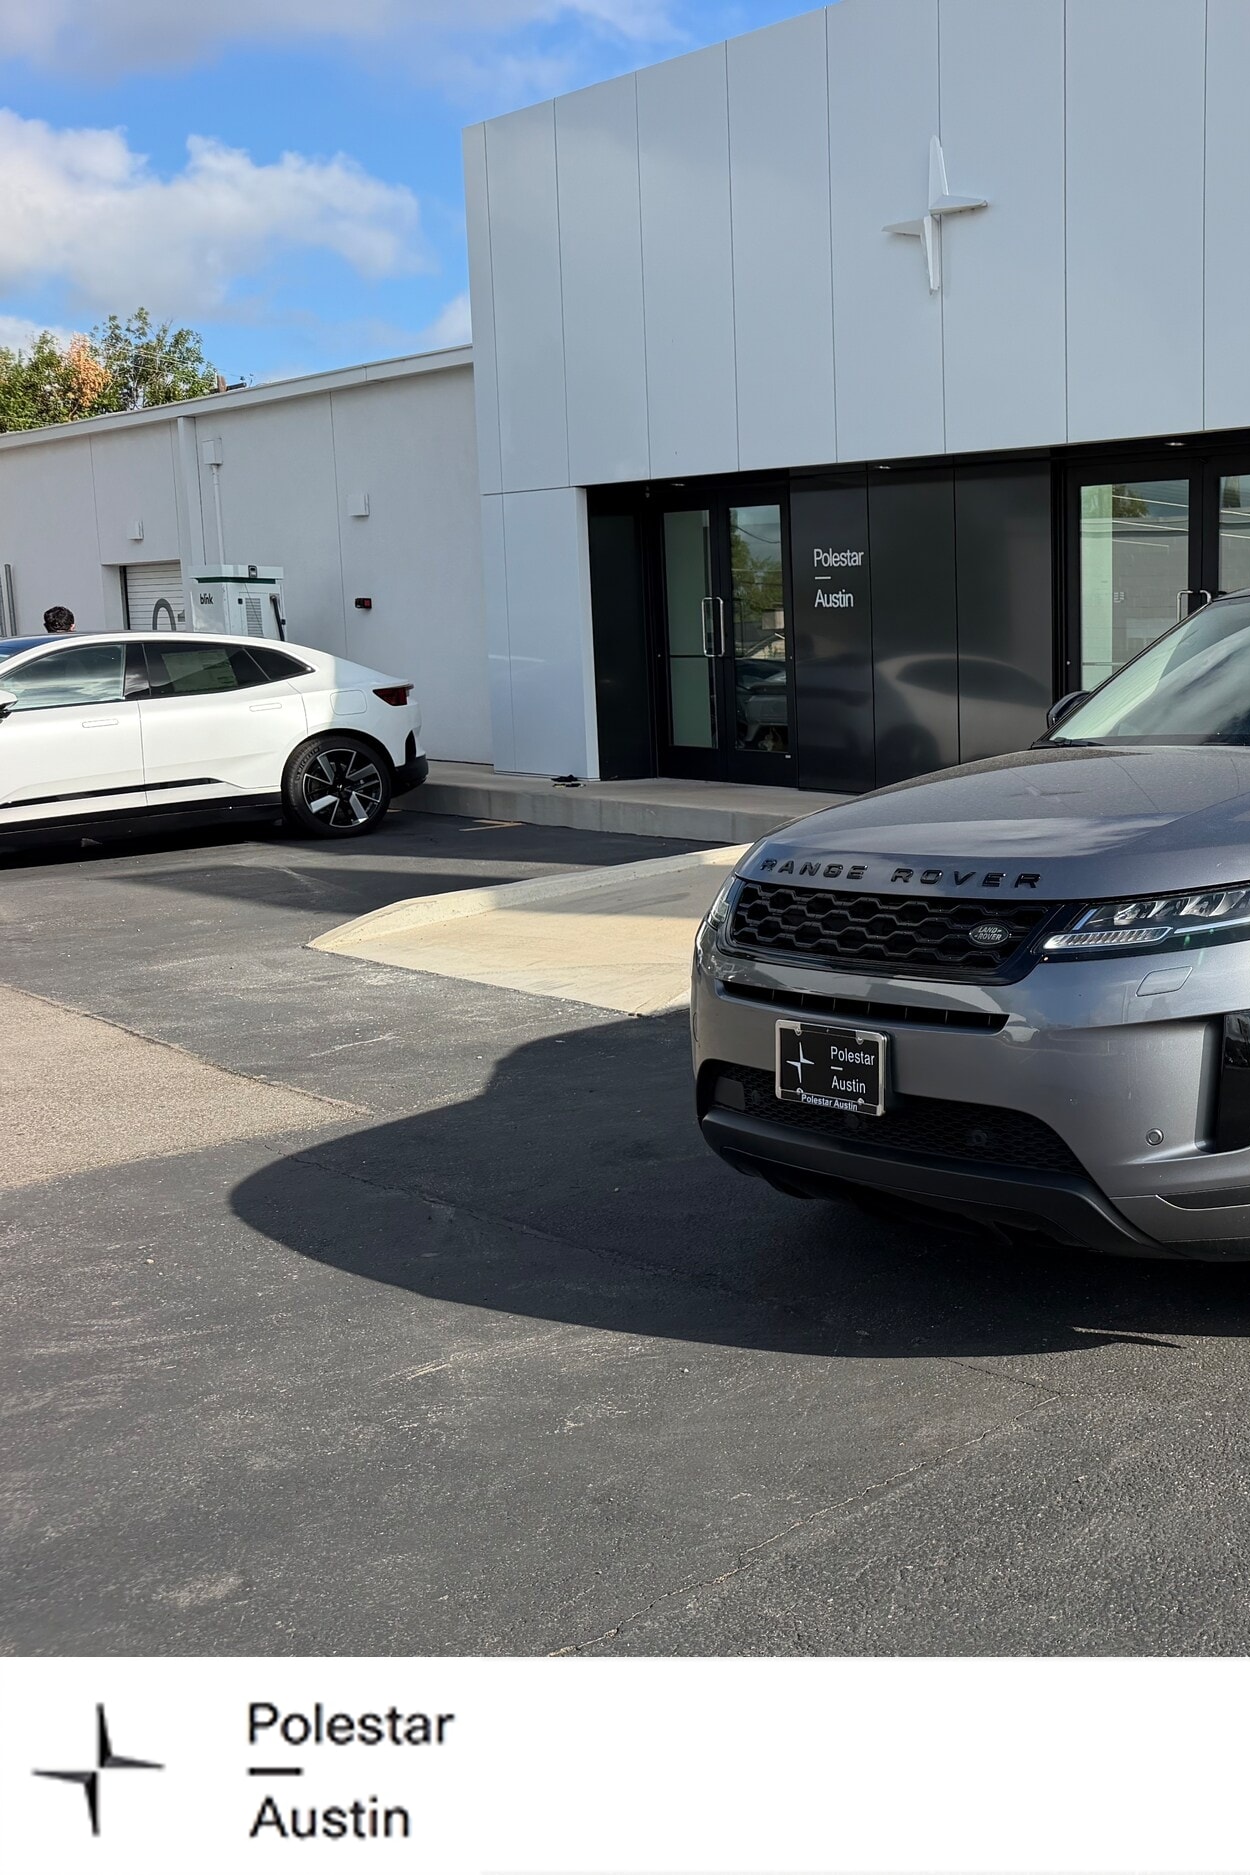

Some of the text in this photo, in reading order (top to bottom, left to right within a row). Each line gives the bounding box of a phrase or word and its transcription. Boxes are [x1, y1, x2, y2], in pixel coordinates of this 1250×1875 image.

[813, 548, 864, 567] Polestar
[199, 592, 214, 605] blink
[814, 589, 854, 608] Austin
[759, 858, 1042, 889] RANGE ROVER
[830, 1046, 875, 1066] Polestar
[831, 1075, 866, 1094] Austin
[801, 1094, 858, 1111] Polestar Austin
